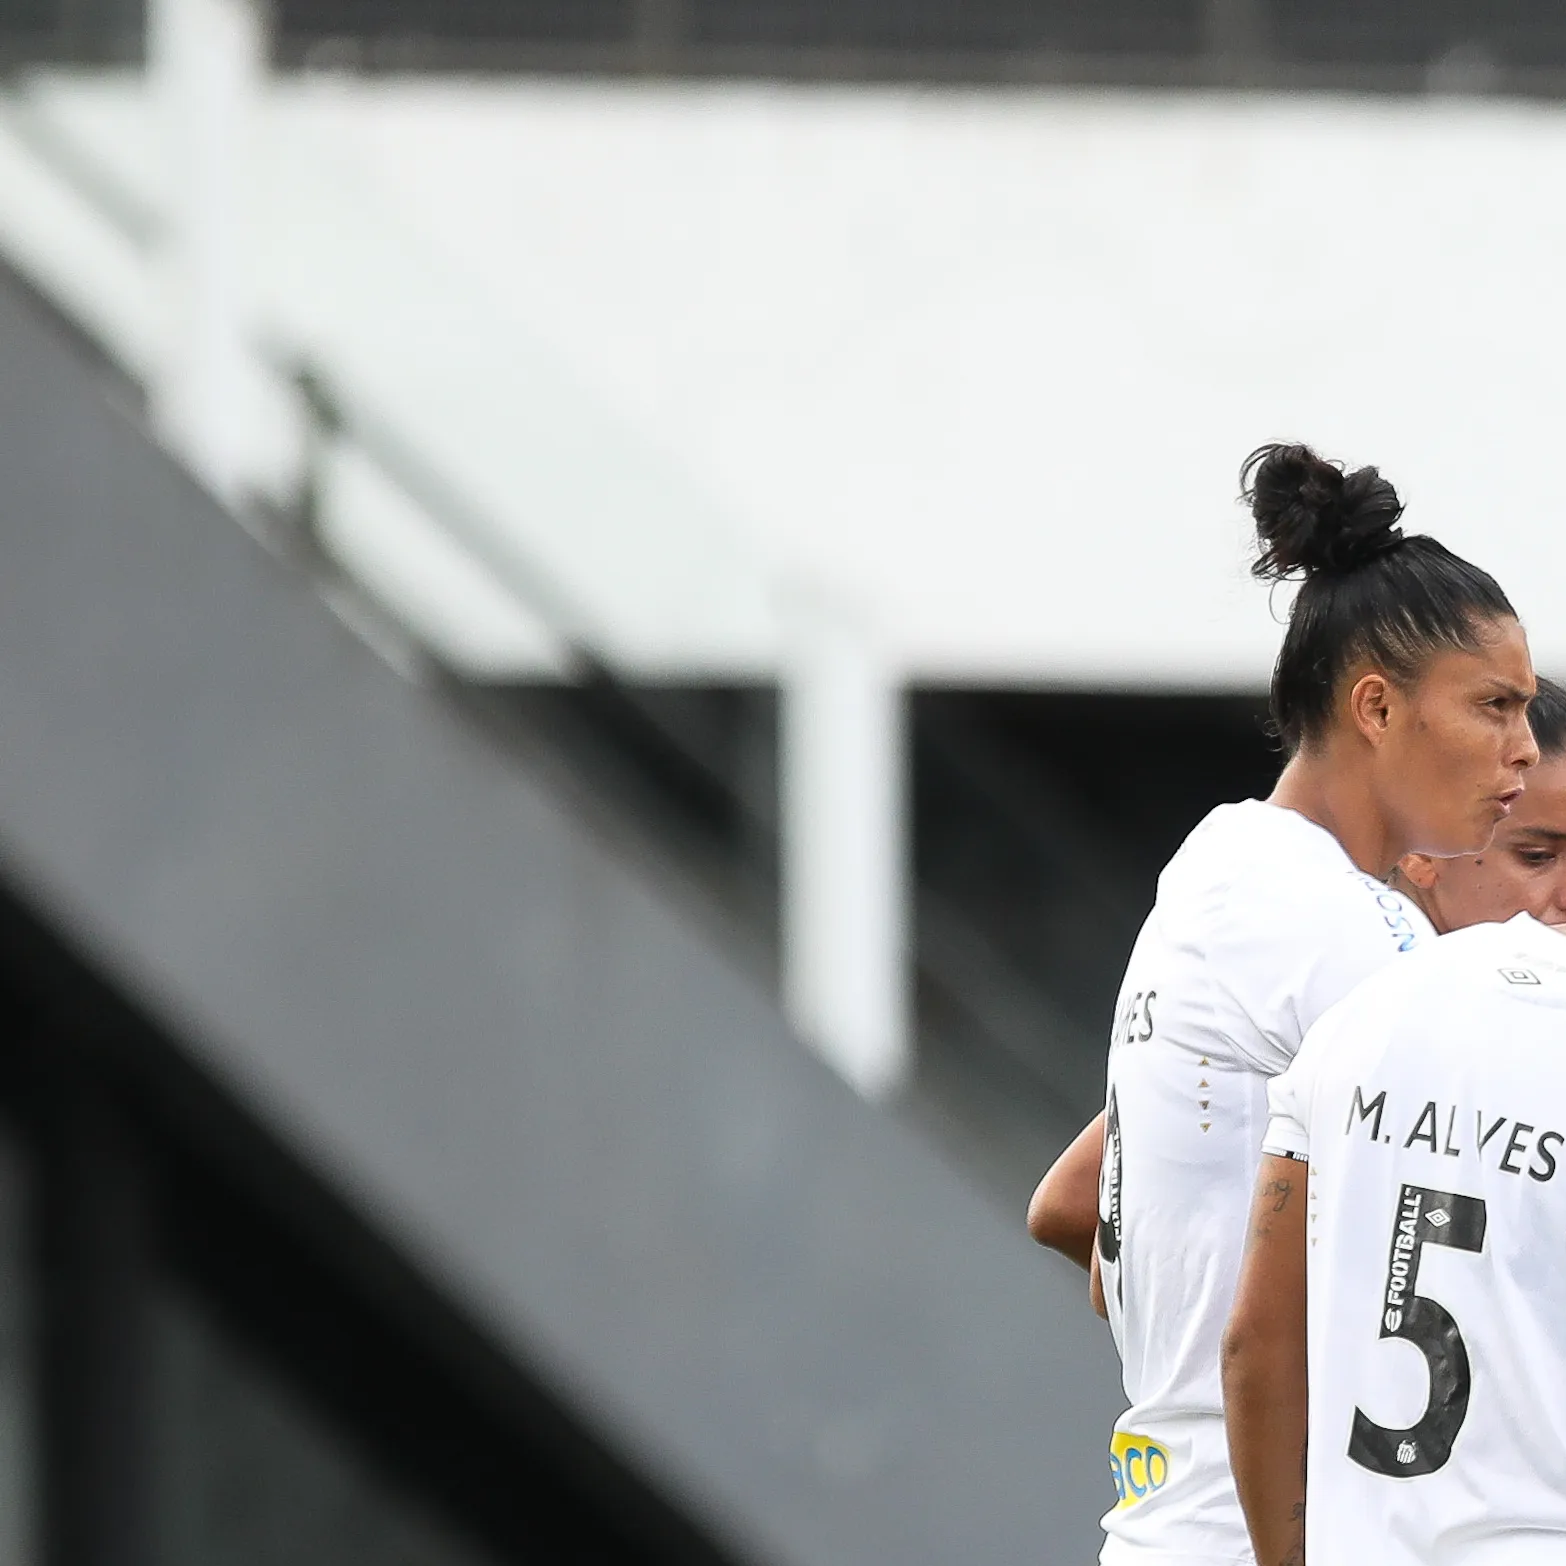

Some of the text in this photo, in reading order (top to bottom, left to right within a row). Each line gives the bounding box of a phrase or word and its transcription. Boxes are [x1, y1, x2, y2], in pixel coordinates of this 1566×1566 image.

[1345, 1085, 1565, 1183] M. ALVES
[1347, 1182, 1488, 1478] 5
